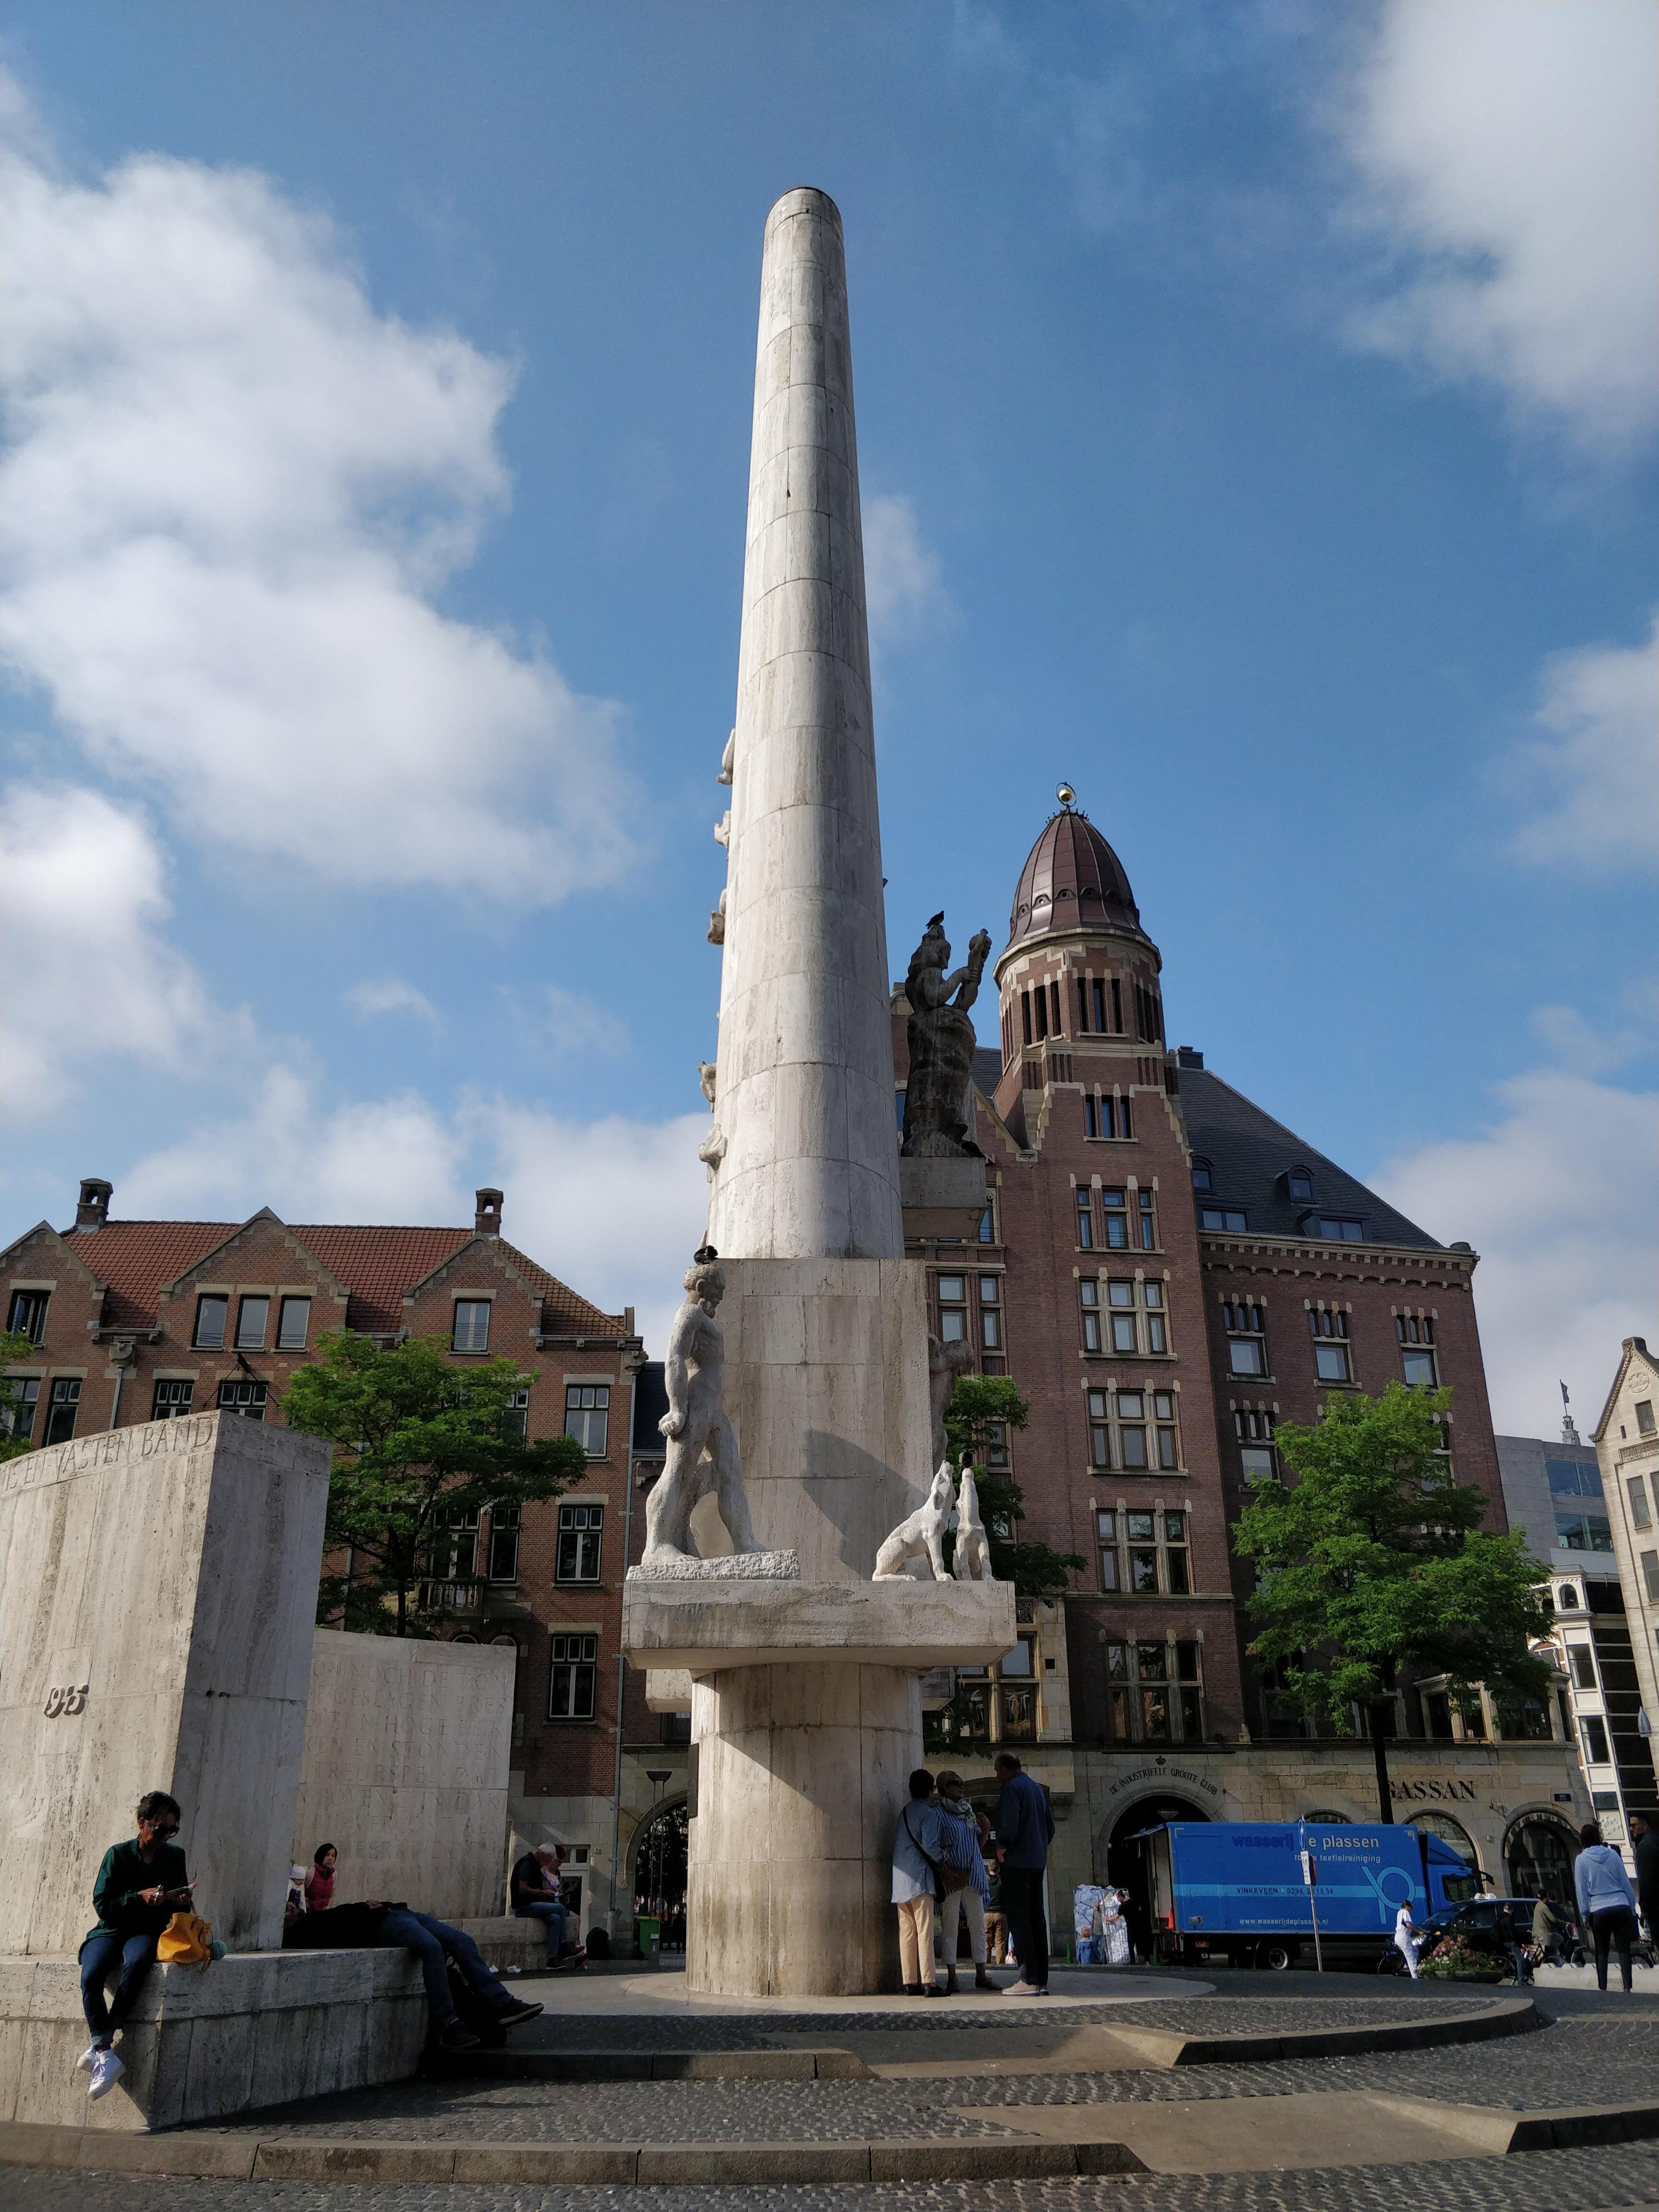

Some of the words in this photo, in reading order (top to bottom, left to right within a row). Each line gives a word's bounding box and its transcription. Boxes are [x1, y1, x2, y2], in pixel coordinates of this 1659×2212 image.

[55, 1431, 134, 1480] VASTEN
[142, 1417, 215, 1456] BAND
[422, 1670, 449, 1688] DE
[1108, 1785, 1120, 1795] DE
[1170, 1768, 1199, 1784] GROOTE
[1200, 1779, 1218, 1795] CLUB
[1231, 1832, 1295, 1851] wasserij
[1322, 1834, 1379, 1851] plassen
